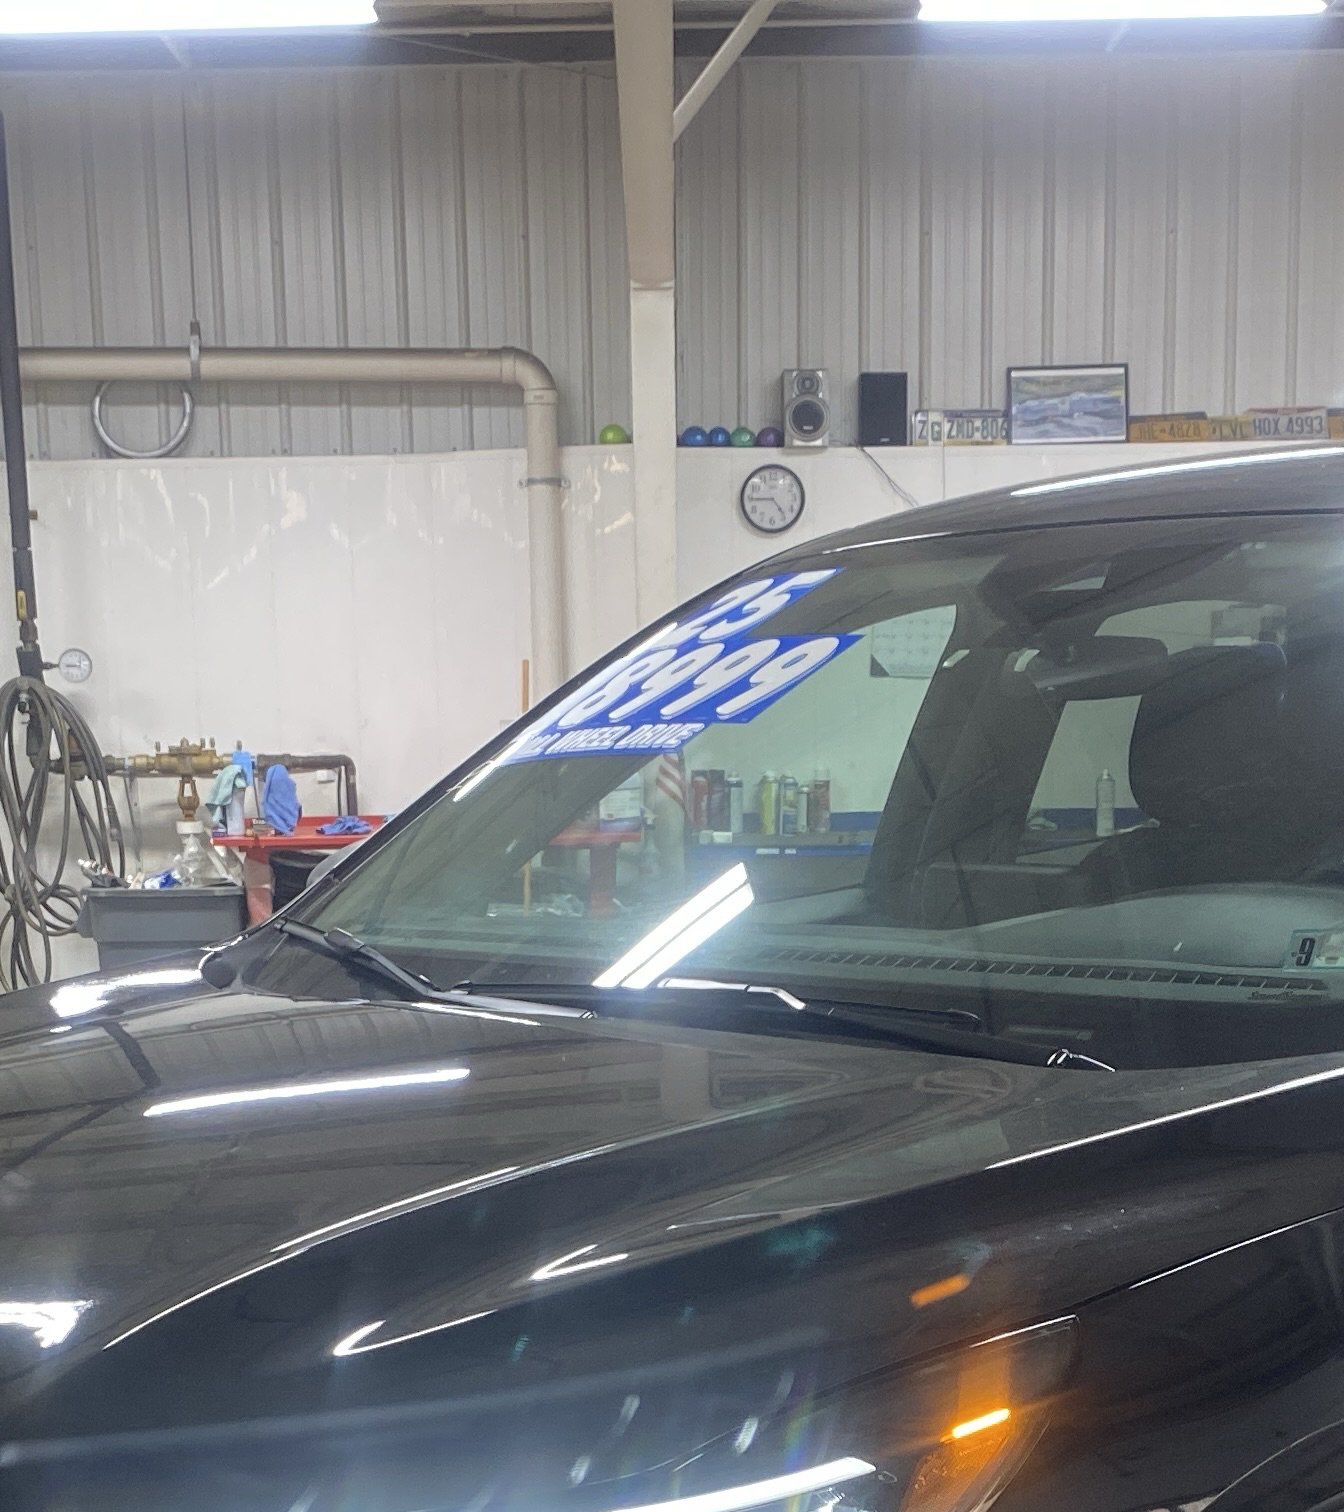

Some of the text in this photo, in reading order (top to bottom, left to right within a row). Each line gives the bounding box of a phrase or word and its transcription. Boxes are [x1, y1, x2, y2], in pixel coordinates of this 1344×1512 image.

[1286, 414, 1324, 436] 4993
[545, 724, 632, 756] WHEEL
[613, 722, 706, 751] DRIVE
[1295, 937, 1316, 967] 9
